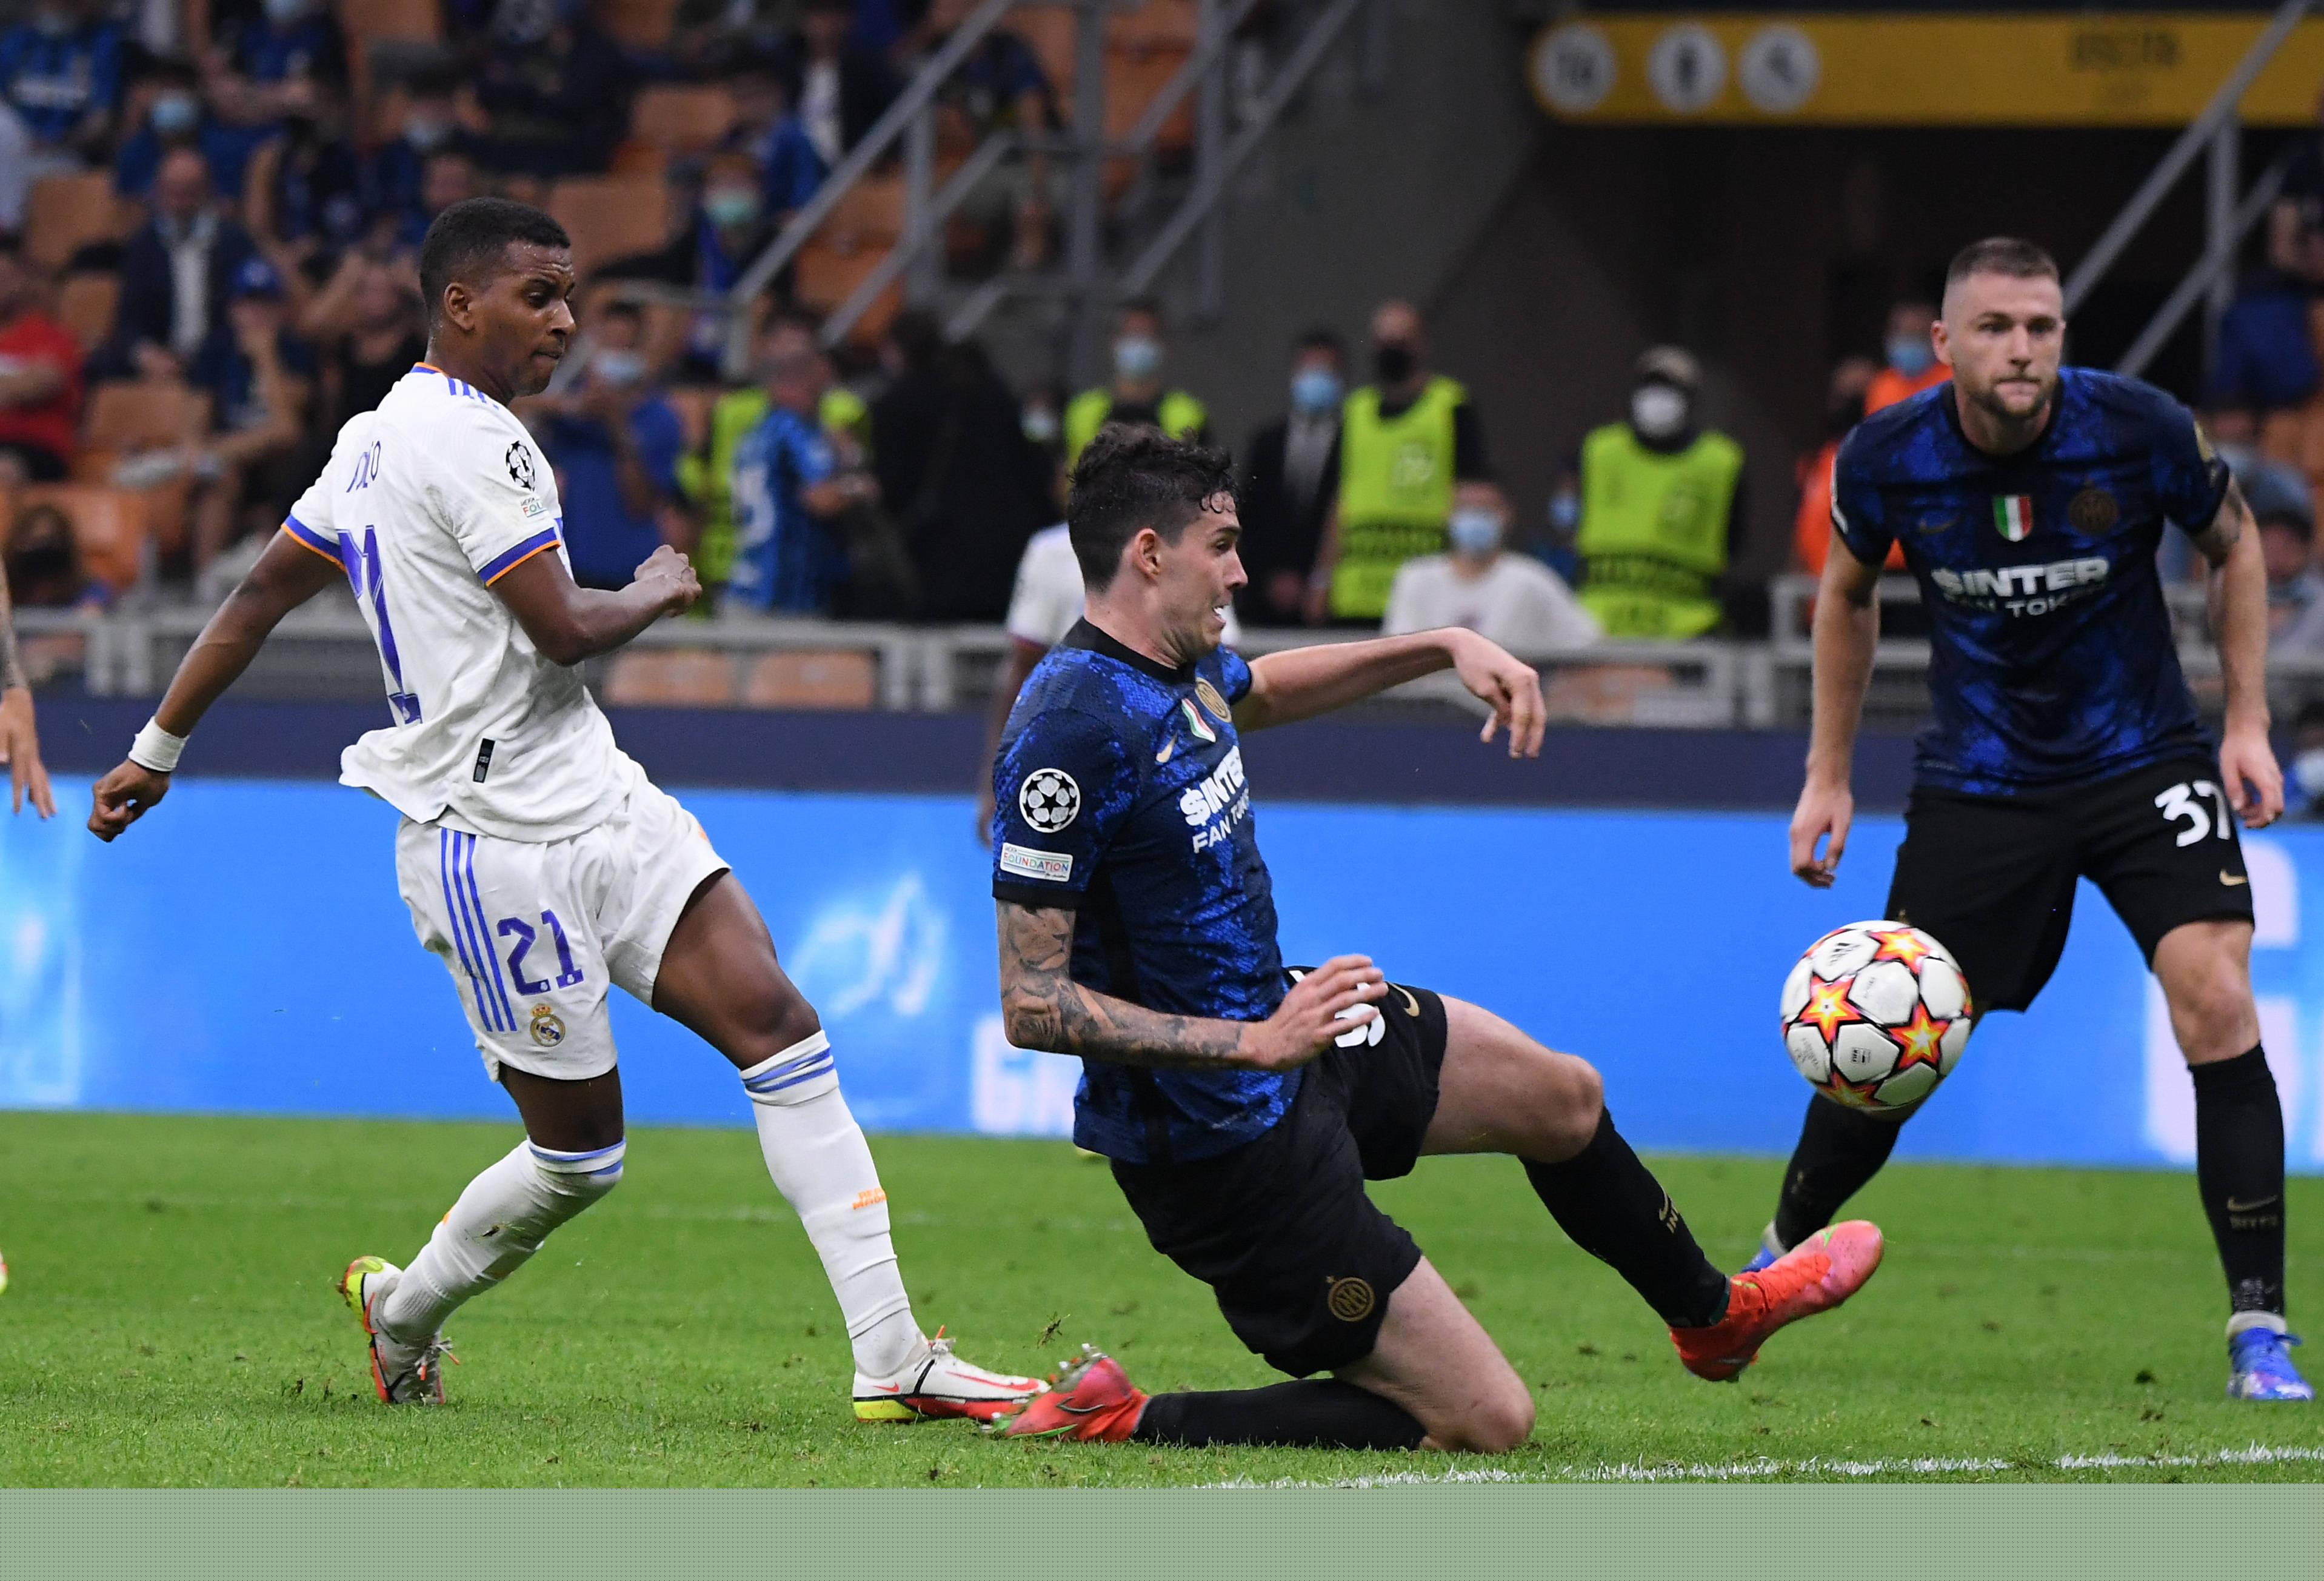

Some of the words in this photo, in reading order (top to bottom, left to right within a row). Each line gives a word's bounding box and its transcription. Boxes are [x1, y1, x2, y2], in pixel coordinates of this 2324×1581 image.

[1192, 814, 1232, 854] FAN
[2154, 780, 2231, 847] 37
[1003, 851, 1069, 872] FOUNDATION
[496, 909, 584, 996] 21
